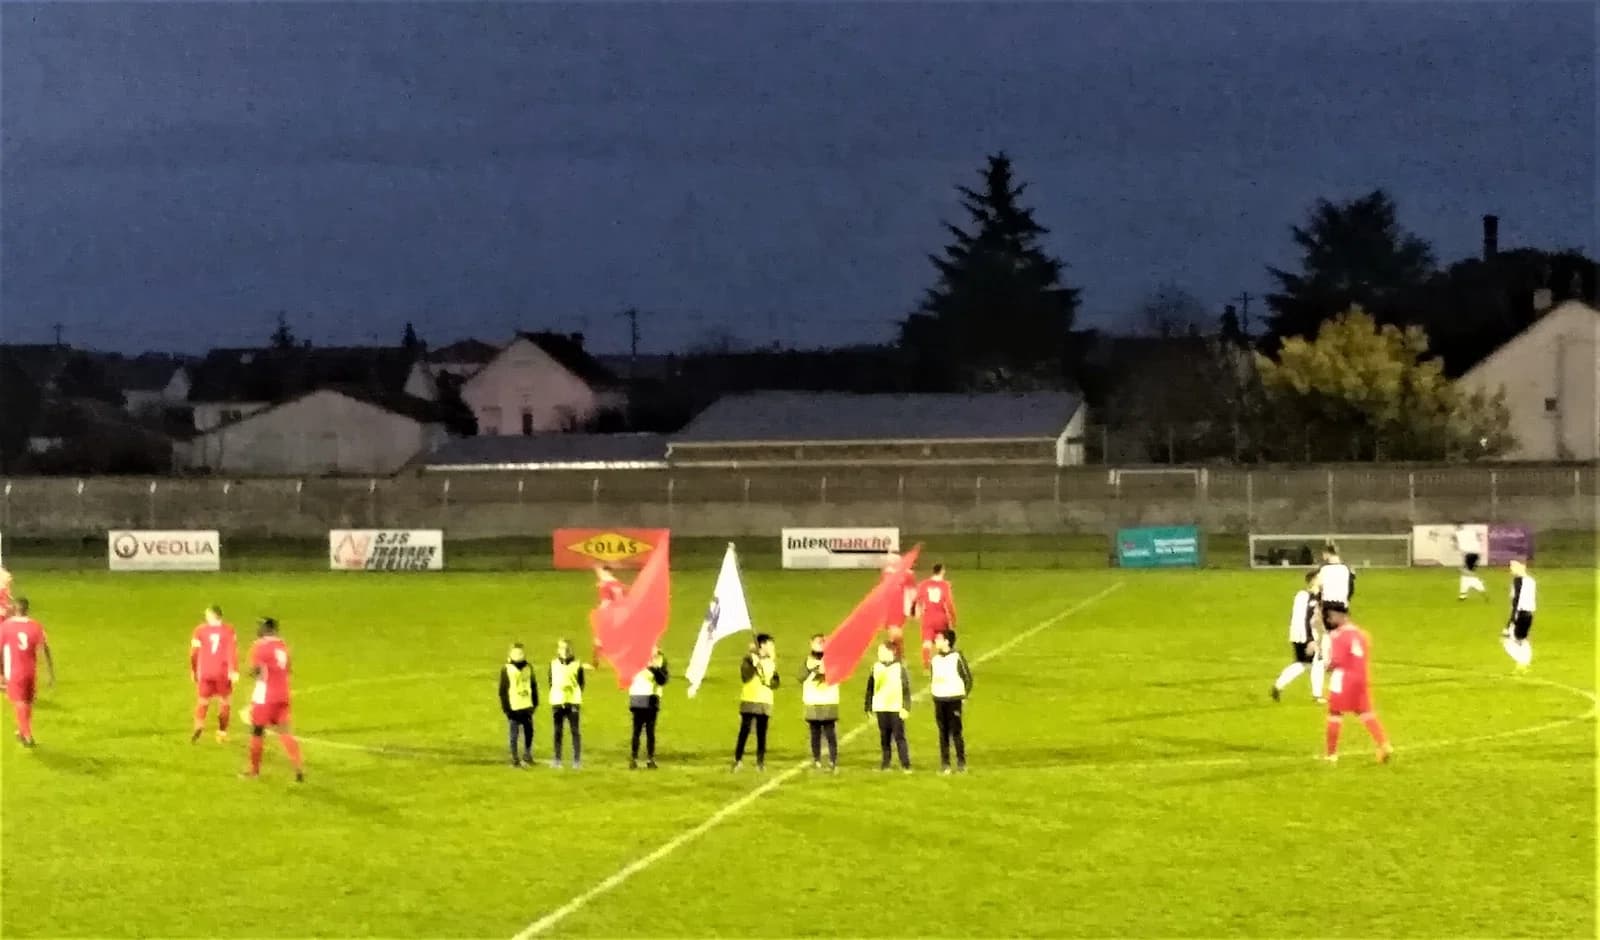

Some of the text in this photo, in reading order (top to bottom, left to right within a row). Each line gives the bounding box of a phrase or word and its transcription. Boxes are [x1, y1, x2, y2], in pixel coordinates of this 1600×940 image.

[143, 540, 214, 555] VEOLIA
[583, 541, 638, 554] COLAS
[16, 631, 28, 651] 3
[209, 633, 220, 655] 7
